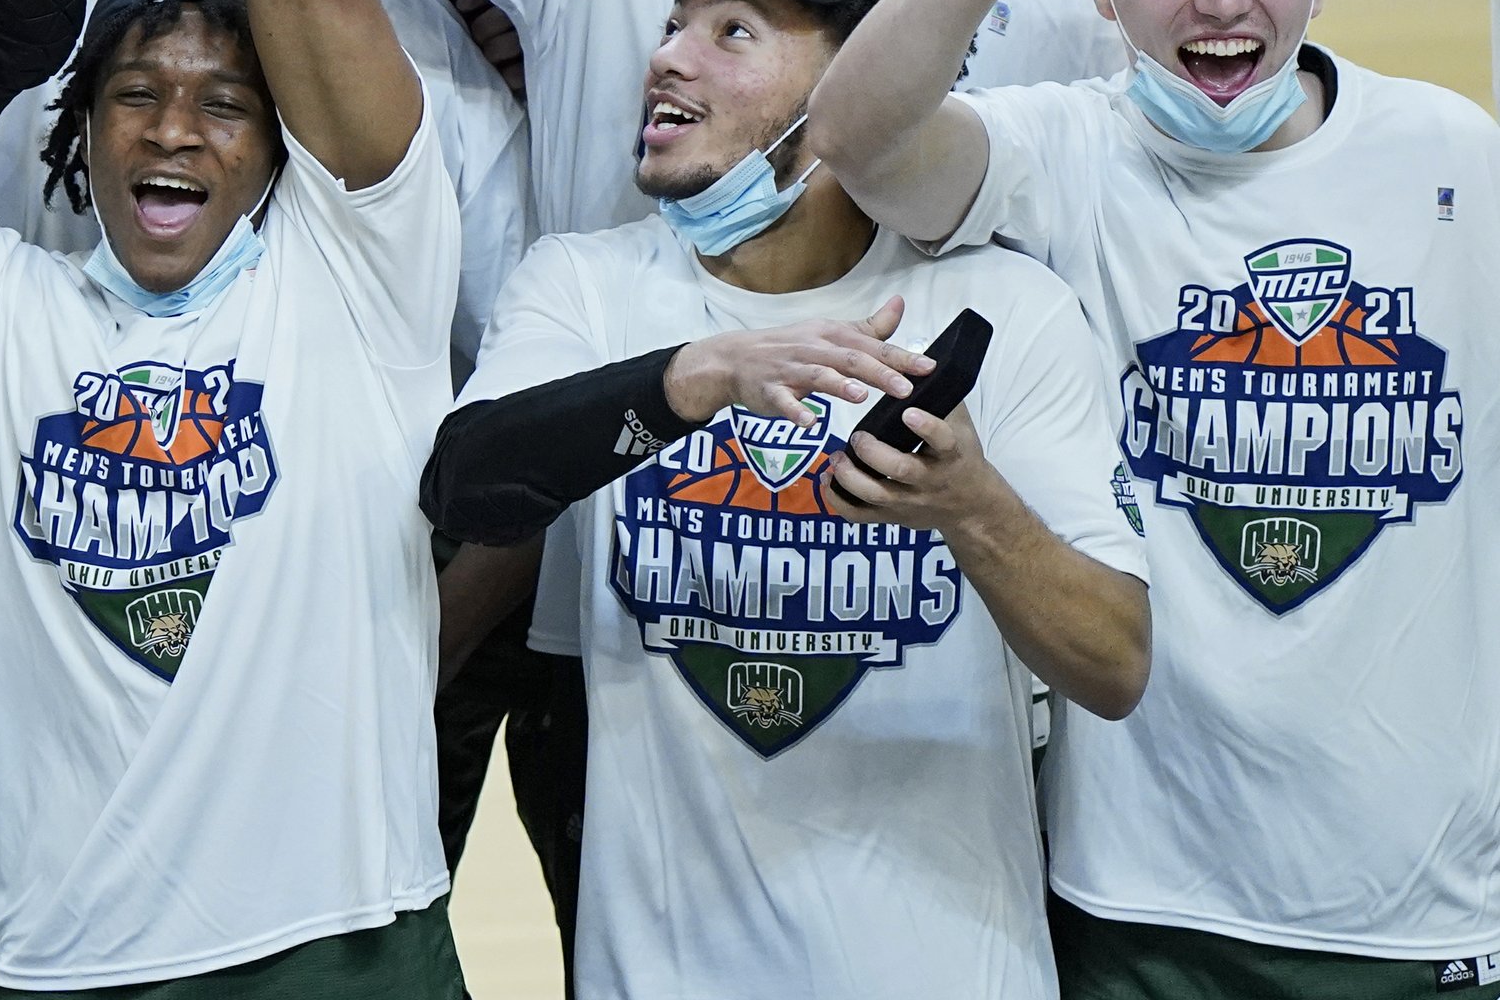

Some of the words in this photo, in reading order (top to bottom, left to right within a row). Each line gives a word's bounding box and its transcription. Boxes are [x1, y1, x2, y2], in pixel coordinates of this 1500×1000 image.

[1283, 252, 1312, 264] 1946
[1255, 269, 1346, 299] MAC
[1180, 289, 1236, 333] 20
[1364, 291, 1413, 335] 21
[75, 373, 120, 422] 20
[154, 374, 176, 386] 194
[1149, 364, 1227, 393] MEN'S
[1242, 369, 1433, 397] TOURNAMENT
[624, 409, 668, 449] didas
[1125, 376, 1462, 483] CHAMPIONS
[43, 441, 110, 480] MEN'S
[1186, 477, 1234, 504] OHIO
[1256, 486, 1391, 508] UNIVERSITY
[637, 496, 704, 534] MEN'S
[1240, 517, 1321, 573] OHIO
[67, 563, 113, 587] OHIO
[669, 619, 720, 642] OHIO
[735, 629, 874, 652] UNIVERSITY
